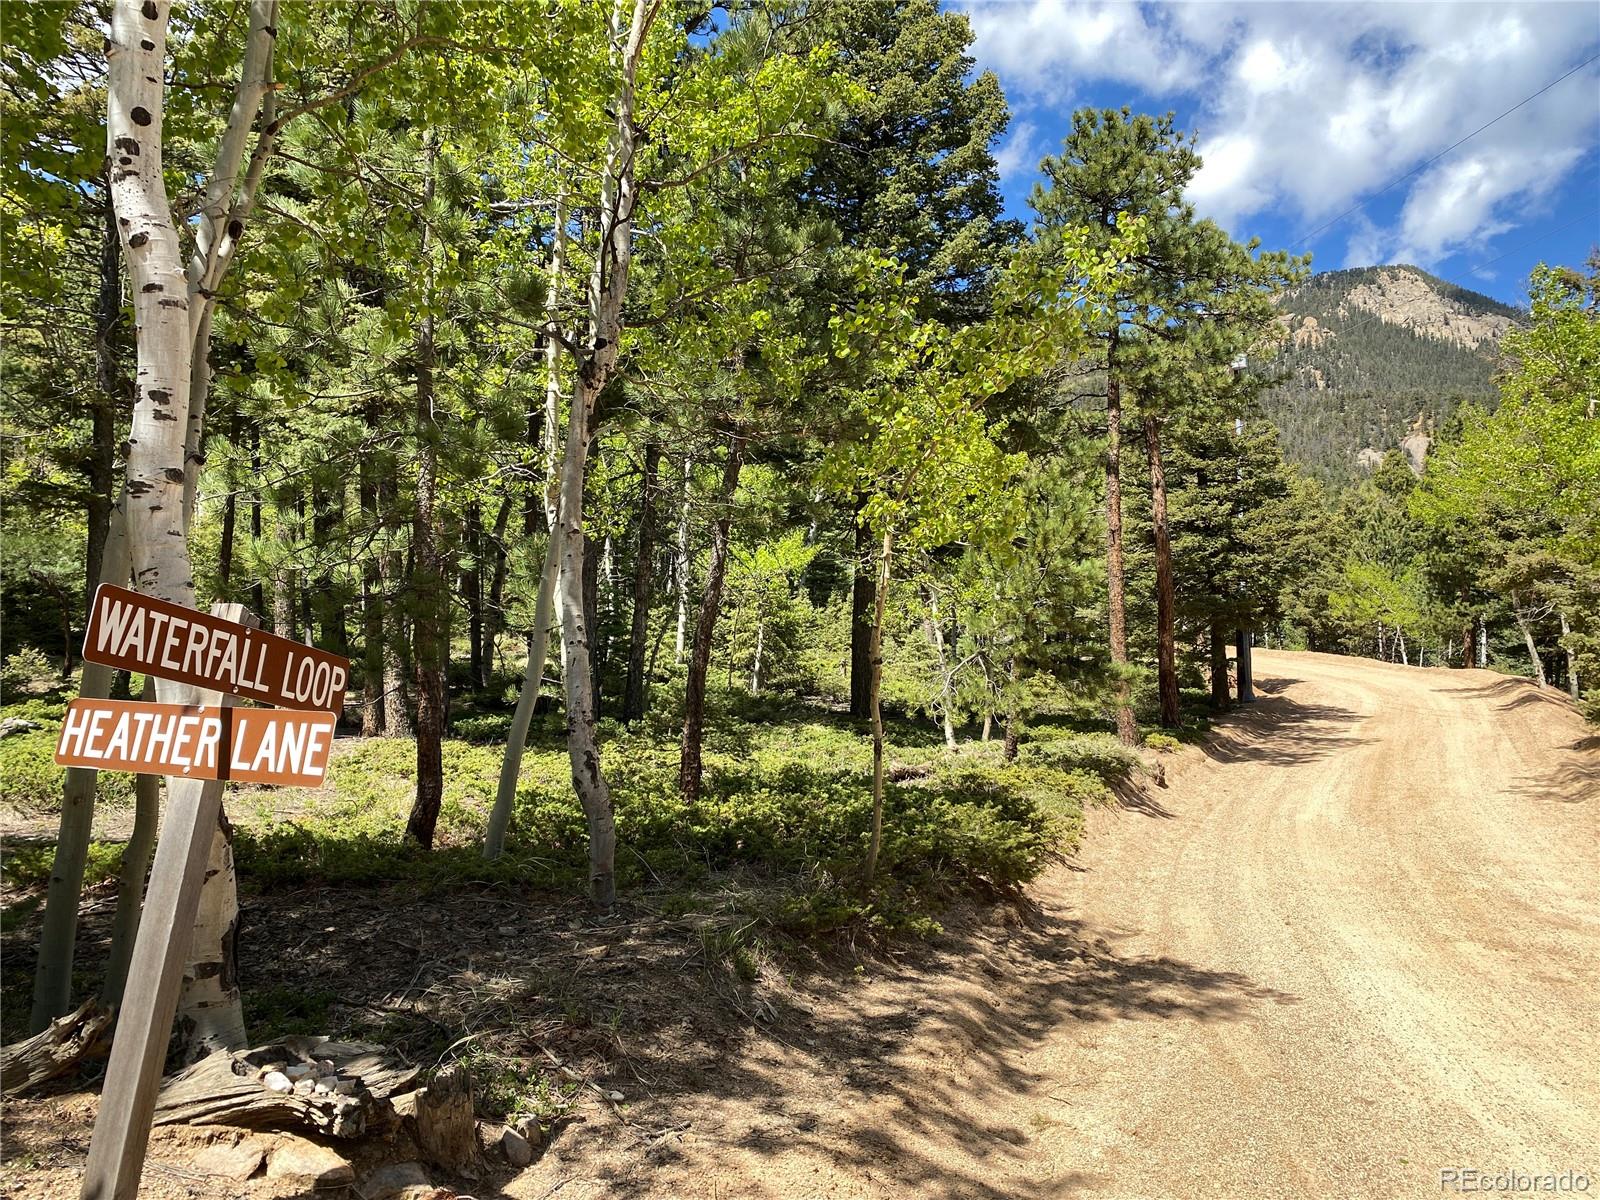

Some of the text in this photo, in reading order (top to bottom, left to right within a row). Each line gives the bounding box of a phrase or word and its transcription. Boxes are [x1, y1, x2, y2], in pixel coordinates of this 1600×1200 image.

[97, 596, 346, 709] WATERFALL LOOP
[59, 707, 332, 776] HEATHER LANE
